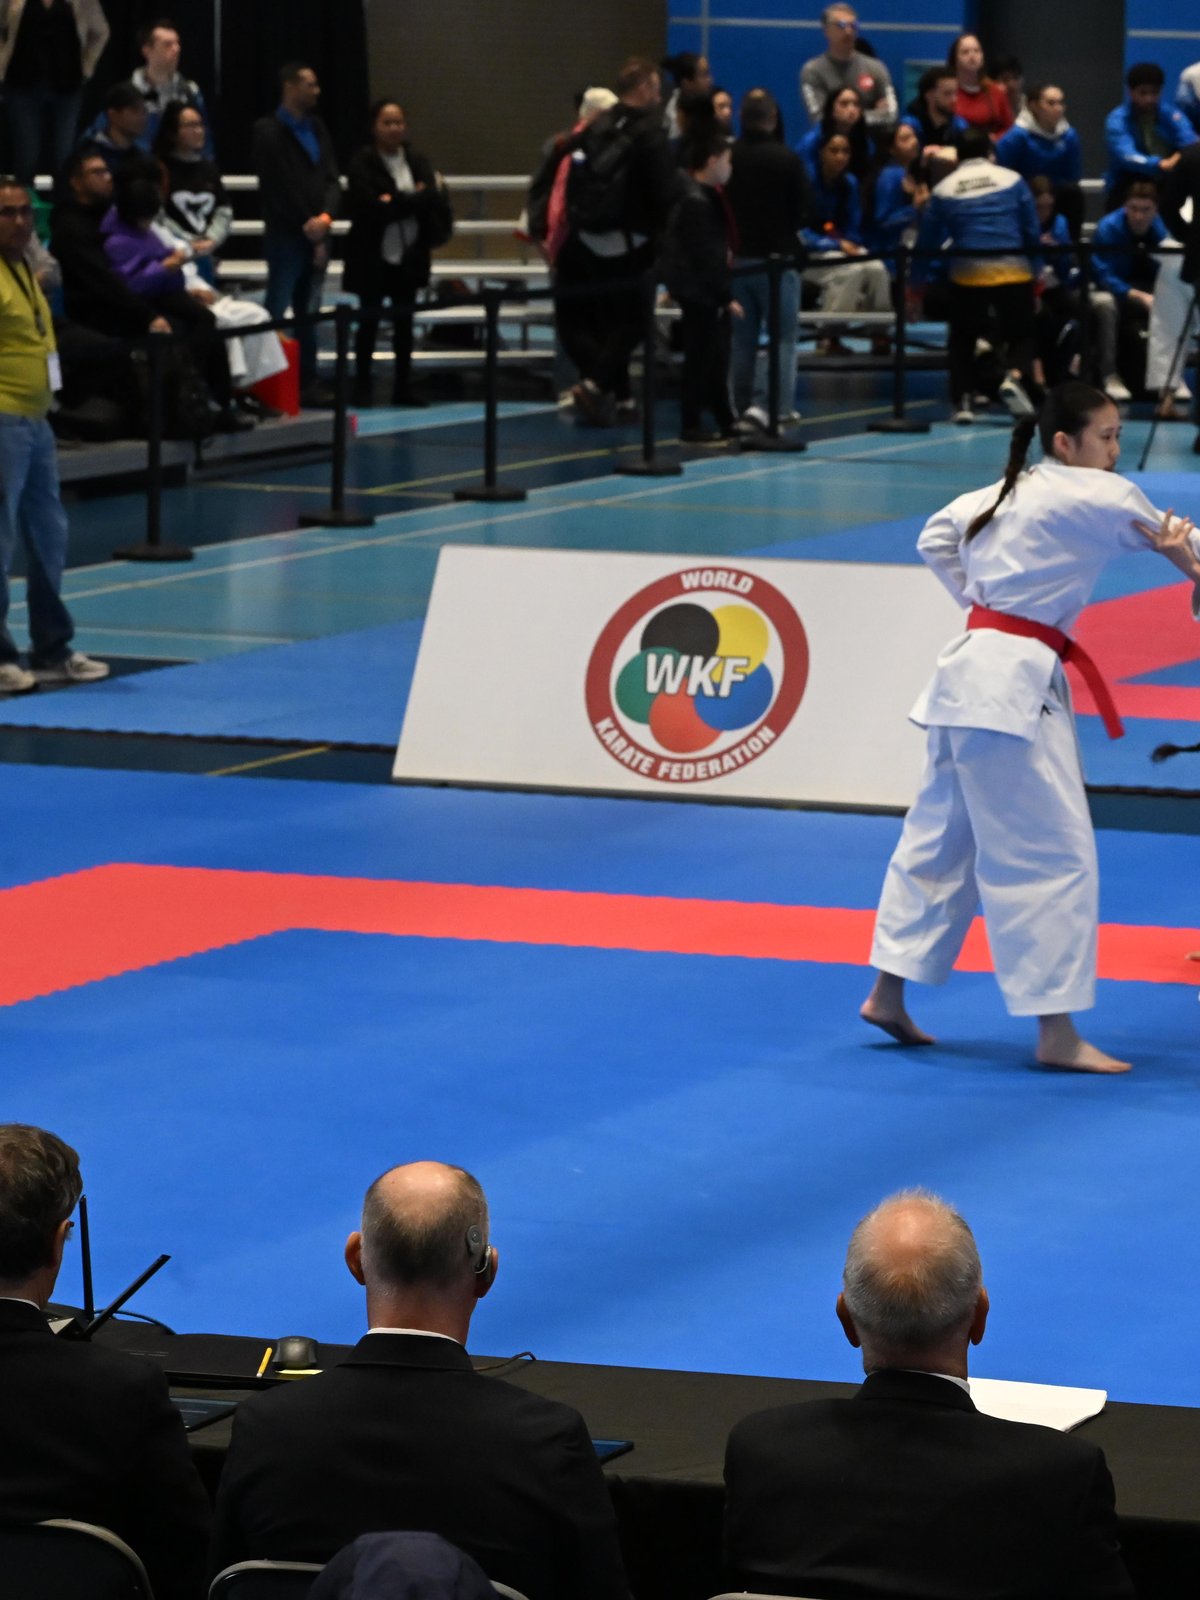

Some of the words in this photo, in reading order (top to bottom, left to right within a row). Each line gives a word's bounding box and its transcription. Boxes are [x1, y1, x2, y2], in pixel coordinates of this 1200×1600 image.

[680, 570, 754, 593] WORLD
[646, 653, 749, 697] WKF
[595, 716, 655, 775] KARATE
[657, 726, 777, 781] FEDERATION
